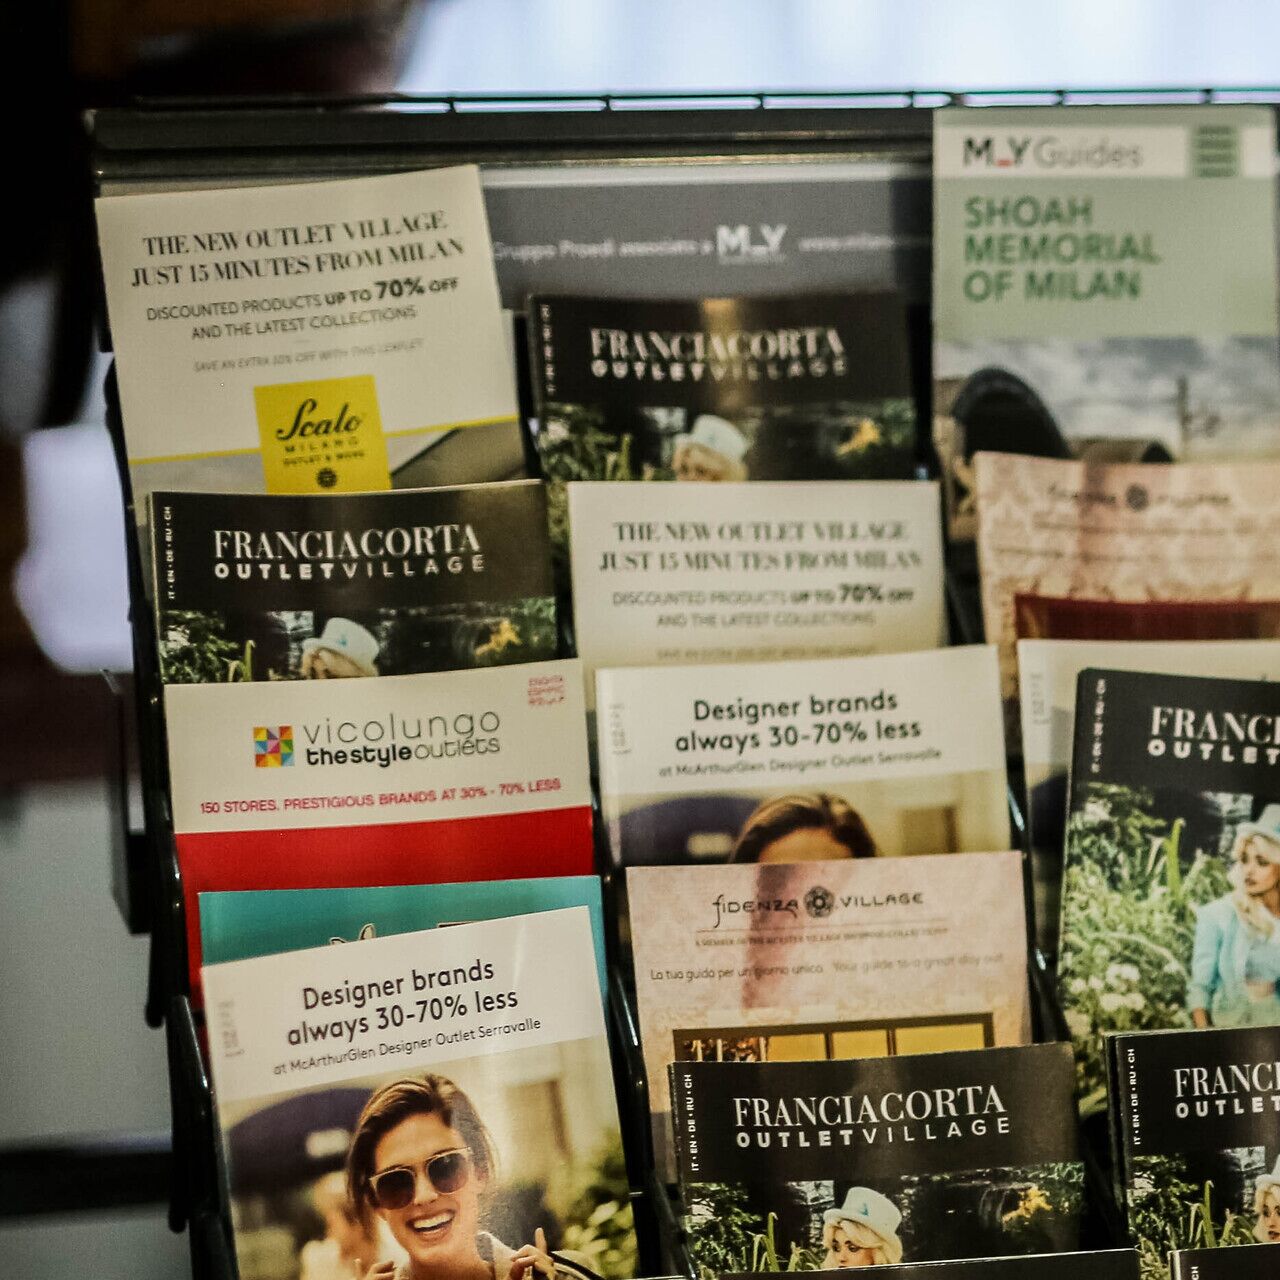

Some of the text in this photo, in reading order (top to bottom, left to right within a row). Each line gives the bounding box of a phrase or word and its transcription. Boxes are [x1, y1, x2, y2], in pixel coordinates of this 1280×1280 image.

[964, 196, 1092, 229] SHOAH
[143, 210, 447, 256] THE NEW OUTLET VILLAGE
[964, 233, 1162, 265] MEMORIAL
[132, 238, 465, 287] JUST 15 MINUTES FROM MILAN
[147, 277, 459, 321] DISCOUNTED PRODUCTS UP TO 70% OFF
[964, 271, 1141, 302] OF MILAN
[192, 305, 417, 340] AND THE LATEST COLLECTIONS
[214, 522, 480, 562] FRANCIACORTA
[303, 710, 500, 745] vicolungo
[693, 690, 899, 726] Designer brands
[674, 717, 923, 756] always 30-70% less
[201, 802, 219, 815] 150
[224, 798, 278, 813] STORES.
[284, 793, 375, 811] PRESTIGIOUS
[379, 790, 436, 808] BRANDS
[441, 789, 456, 803] AT
[460, 786, 487, 801] 30%
[500, 783, 524, 798] 70%
[528, 779, 562, 796] LESS
[303, 958, 495, 1012] Designer brands
[287, 988, 519, 1049] always 30-70% less
[273, 1016, 542, 1076] at McArthurGlen Designer Outlet Serravalle
[733, 1082, 1005, 1127] FRANCIACORTA
